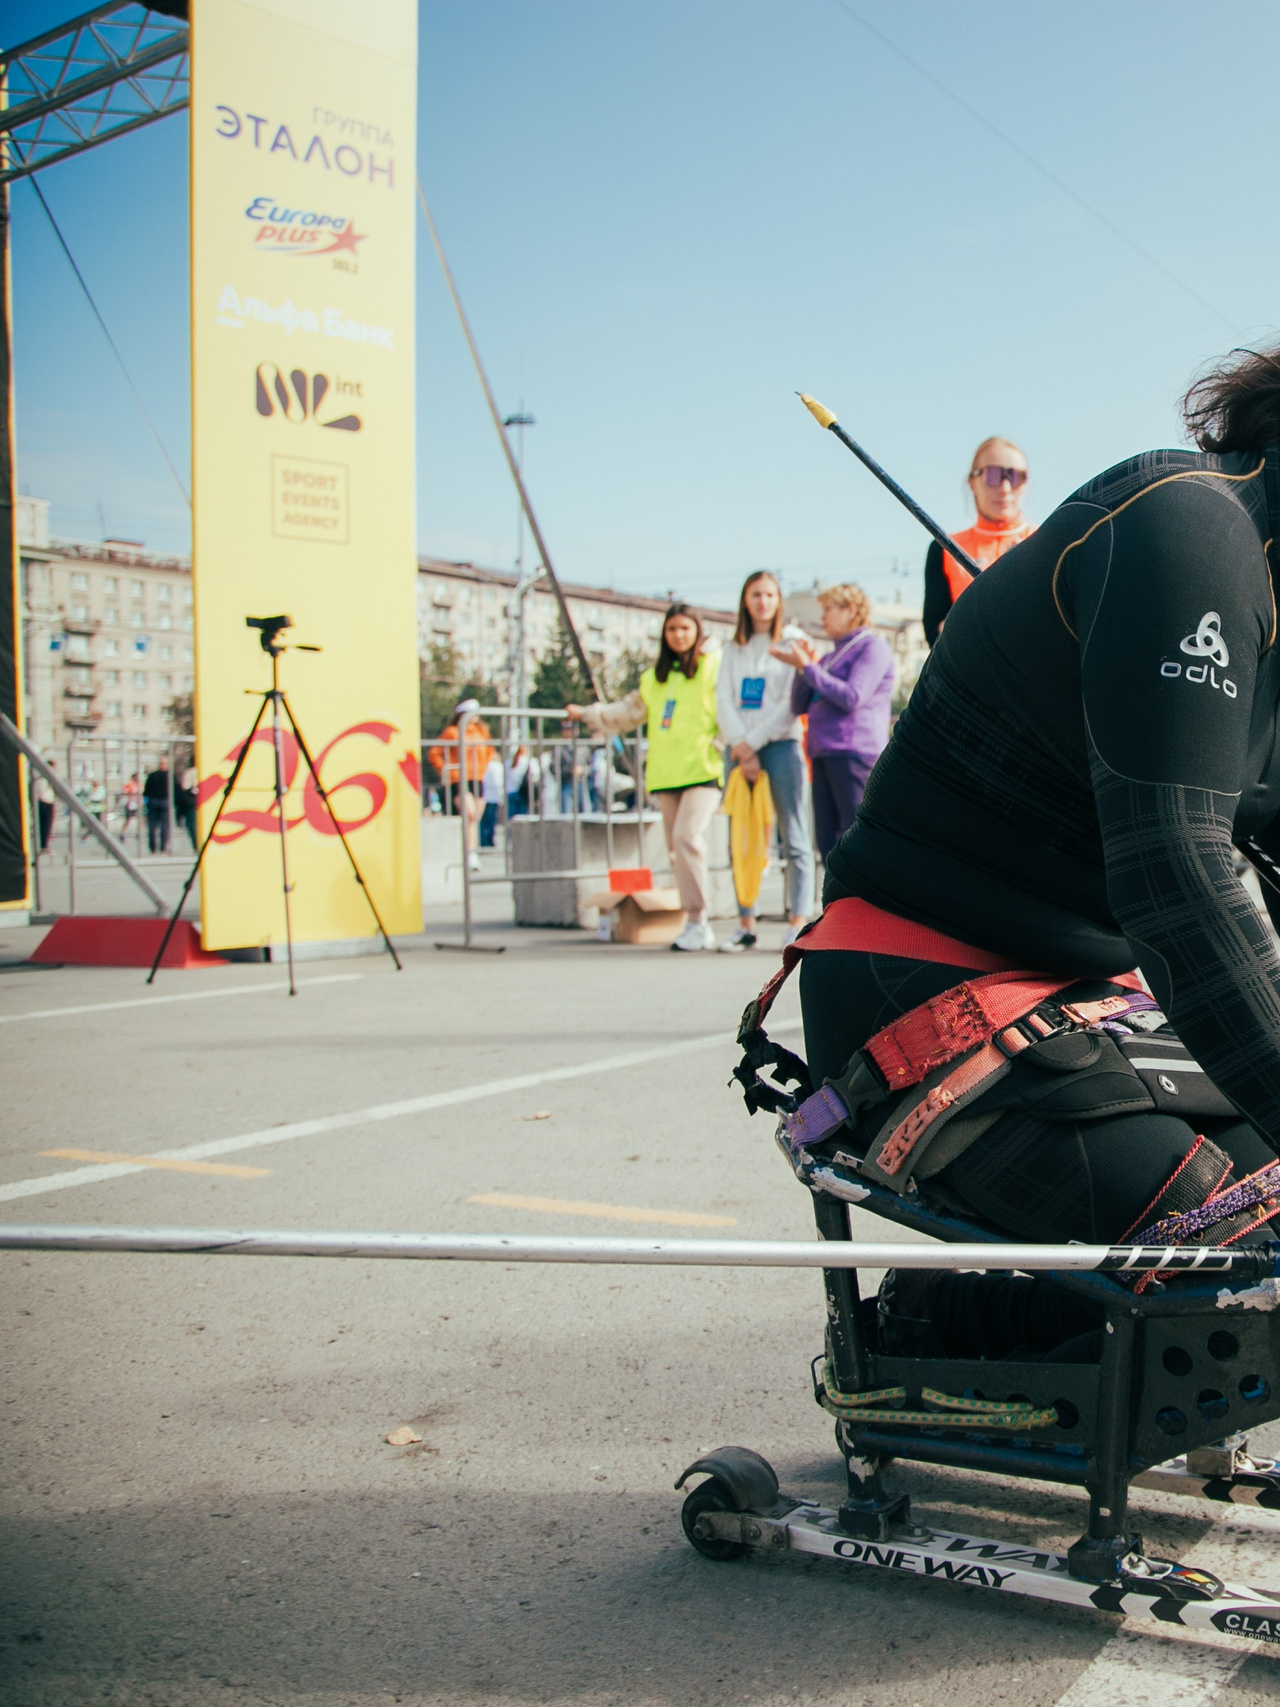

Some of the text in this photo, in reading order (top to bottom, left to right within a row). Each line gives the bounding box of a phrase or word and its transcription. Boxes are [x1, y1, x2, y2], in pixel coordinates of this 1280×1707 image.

[312, 106, 395, 148] ГРУППА
[215, 104, 395, 189] ЭТАЛОН
[216, 284, 396, 350] Альфа Банк
[281, 469, 339, 491] SPORT
[281, 489, 340, 511] EVENTS
[282, 511, 340, 530] AGENCY
[1160, 661, 1238, 699] odlo
